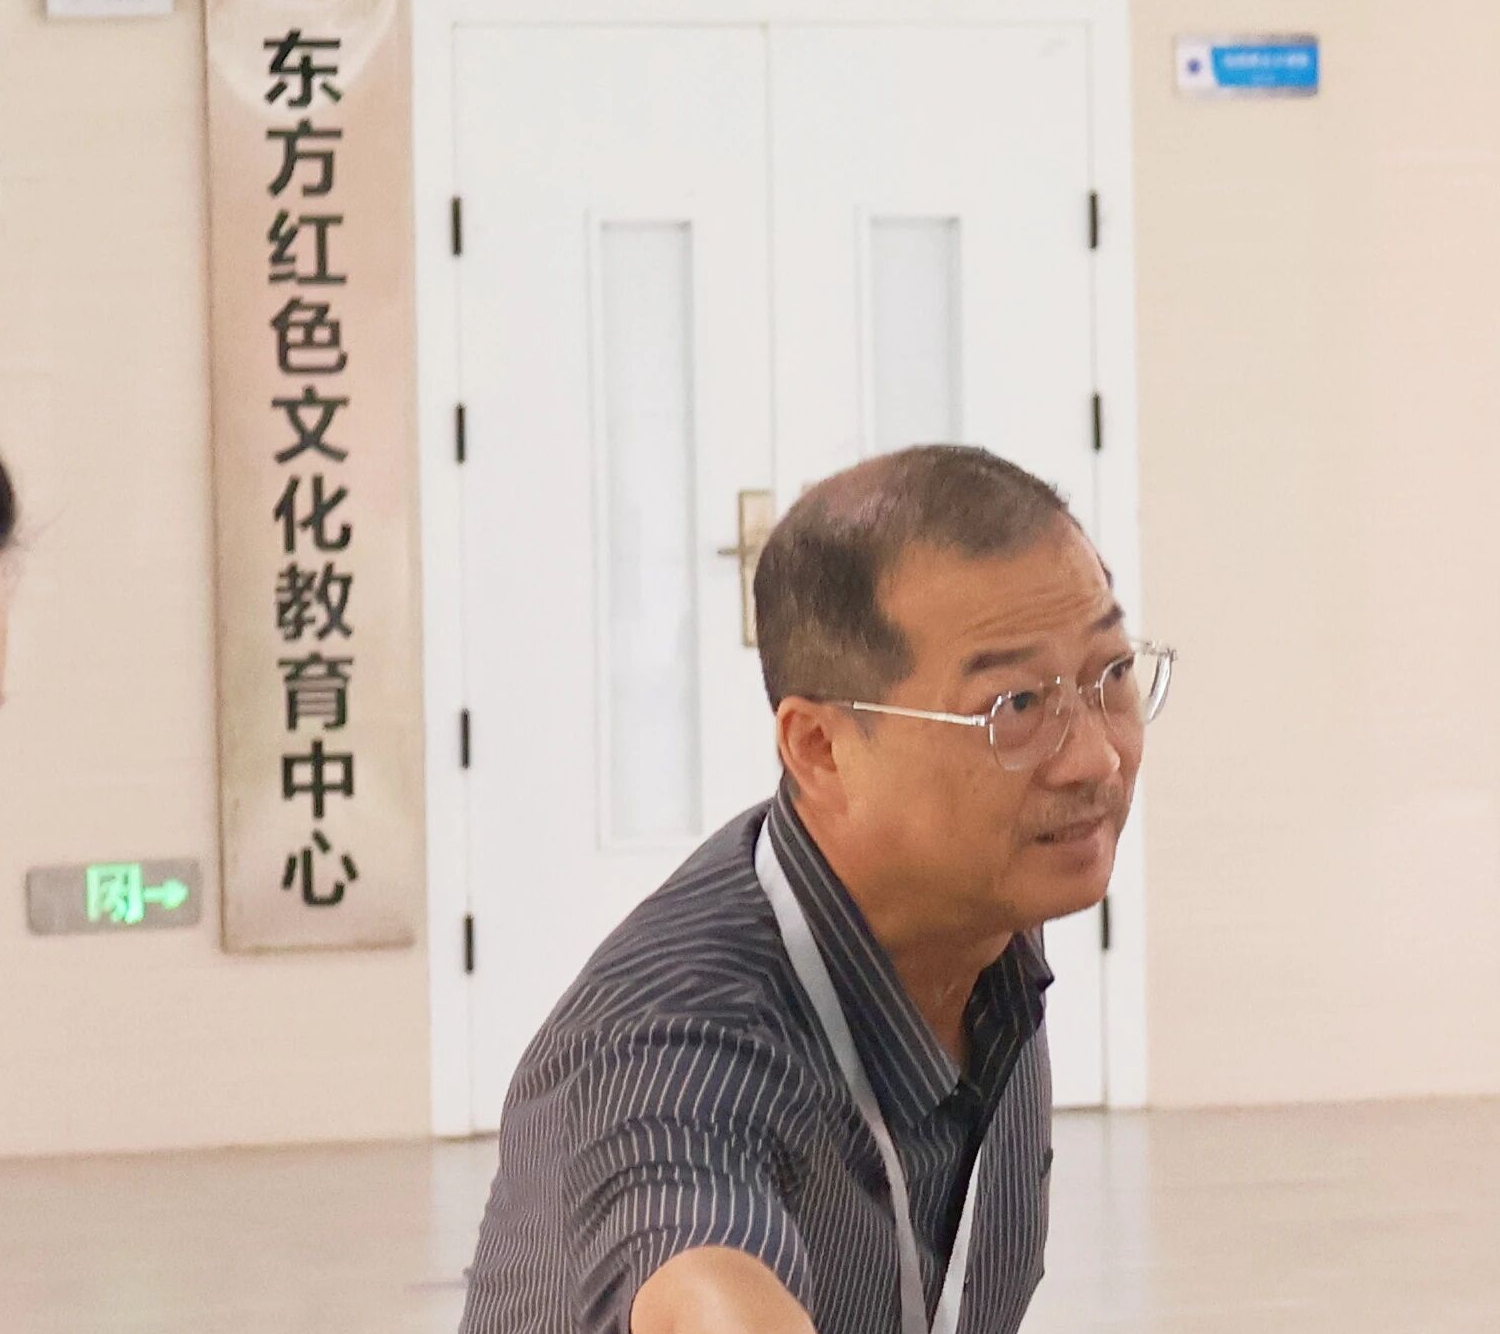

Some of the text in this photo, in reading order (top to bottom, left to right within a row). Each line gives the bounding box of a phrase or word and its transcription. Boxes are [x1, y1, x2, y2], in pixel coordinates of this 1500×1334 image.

[262, 28, 359, 909] 东方红色文化教育中心
